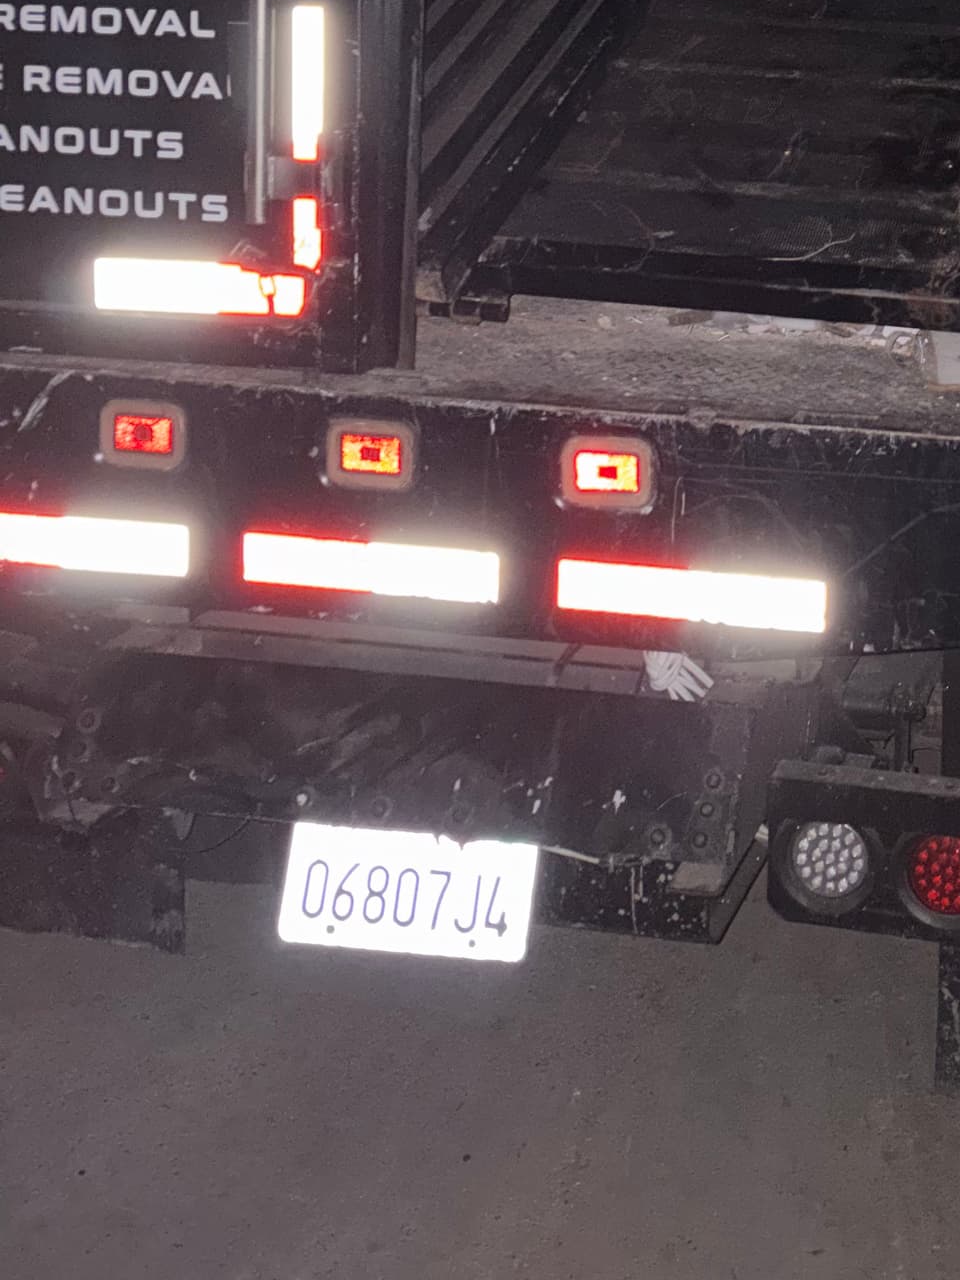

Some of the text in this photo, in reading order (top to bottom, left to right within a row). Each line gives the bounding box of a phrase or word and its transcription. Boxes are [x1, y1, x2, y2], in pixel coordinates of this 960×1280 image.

[23, 65, 233, 100] REMOVA
[0, 184, 228, 222] EANOUTS
[302, 859, 507, 937] 06807J4
